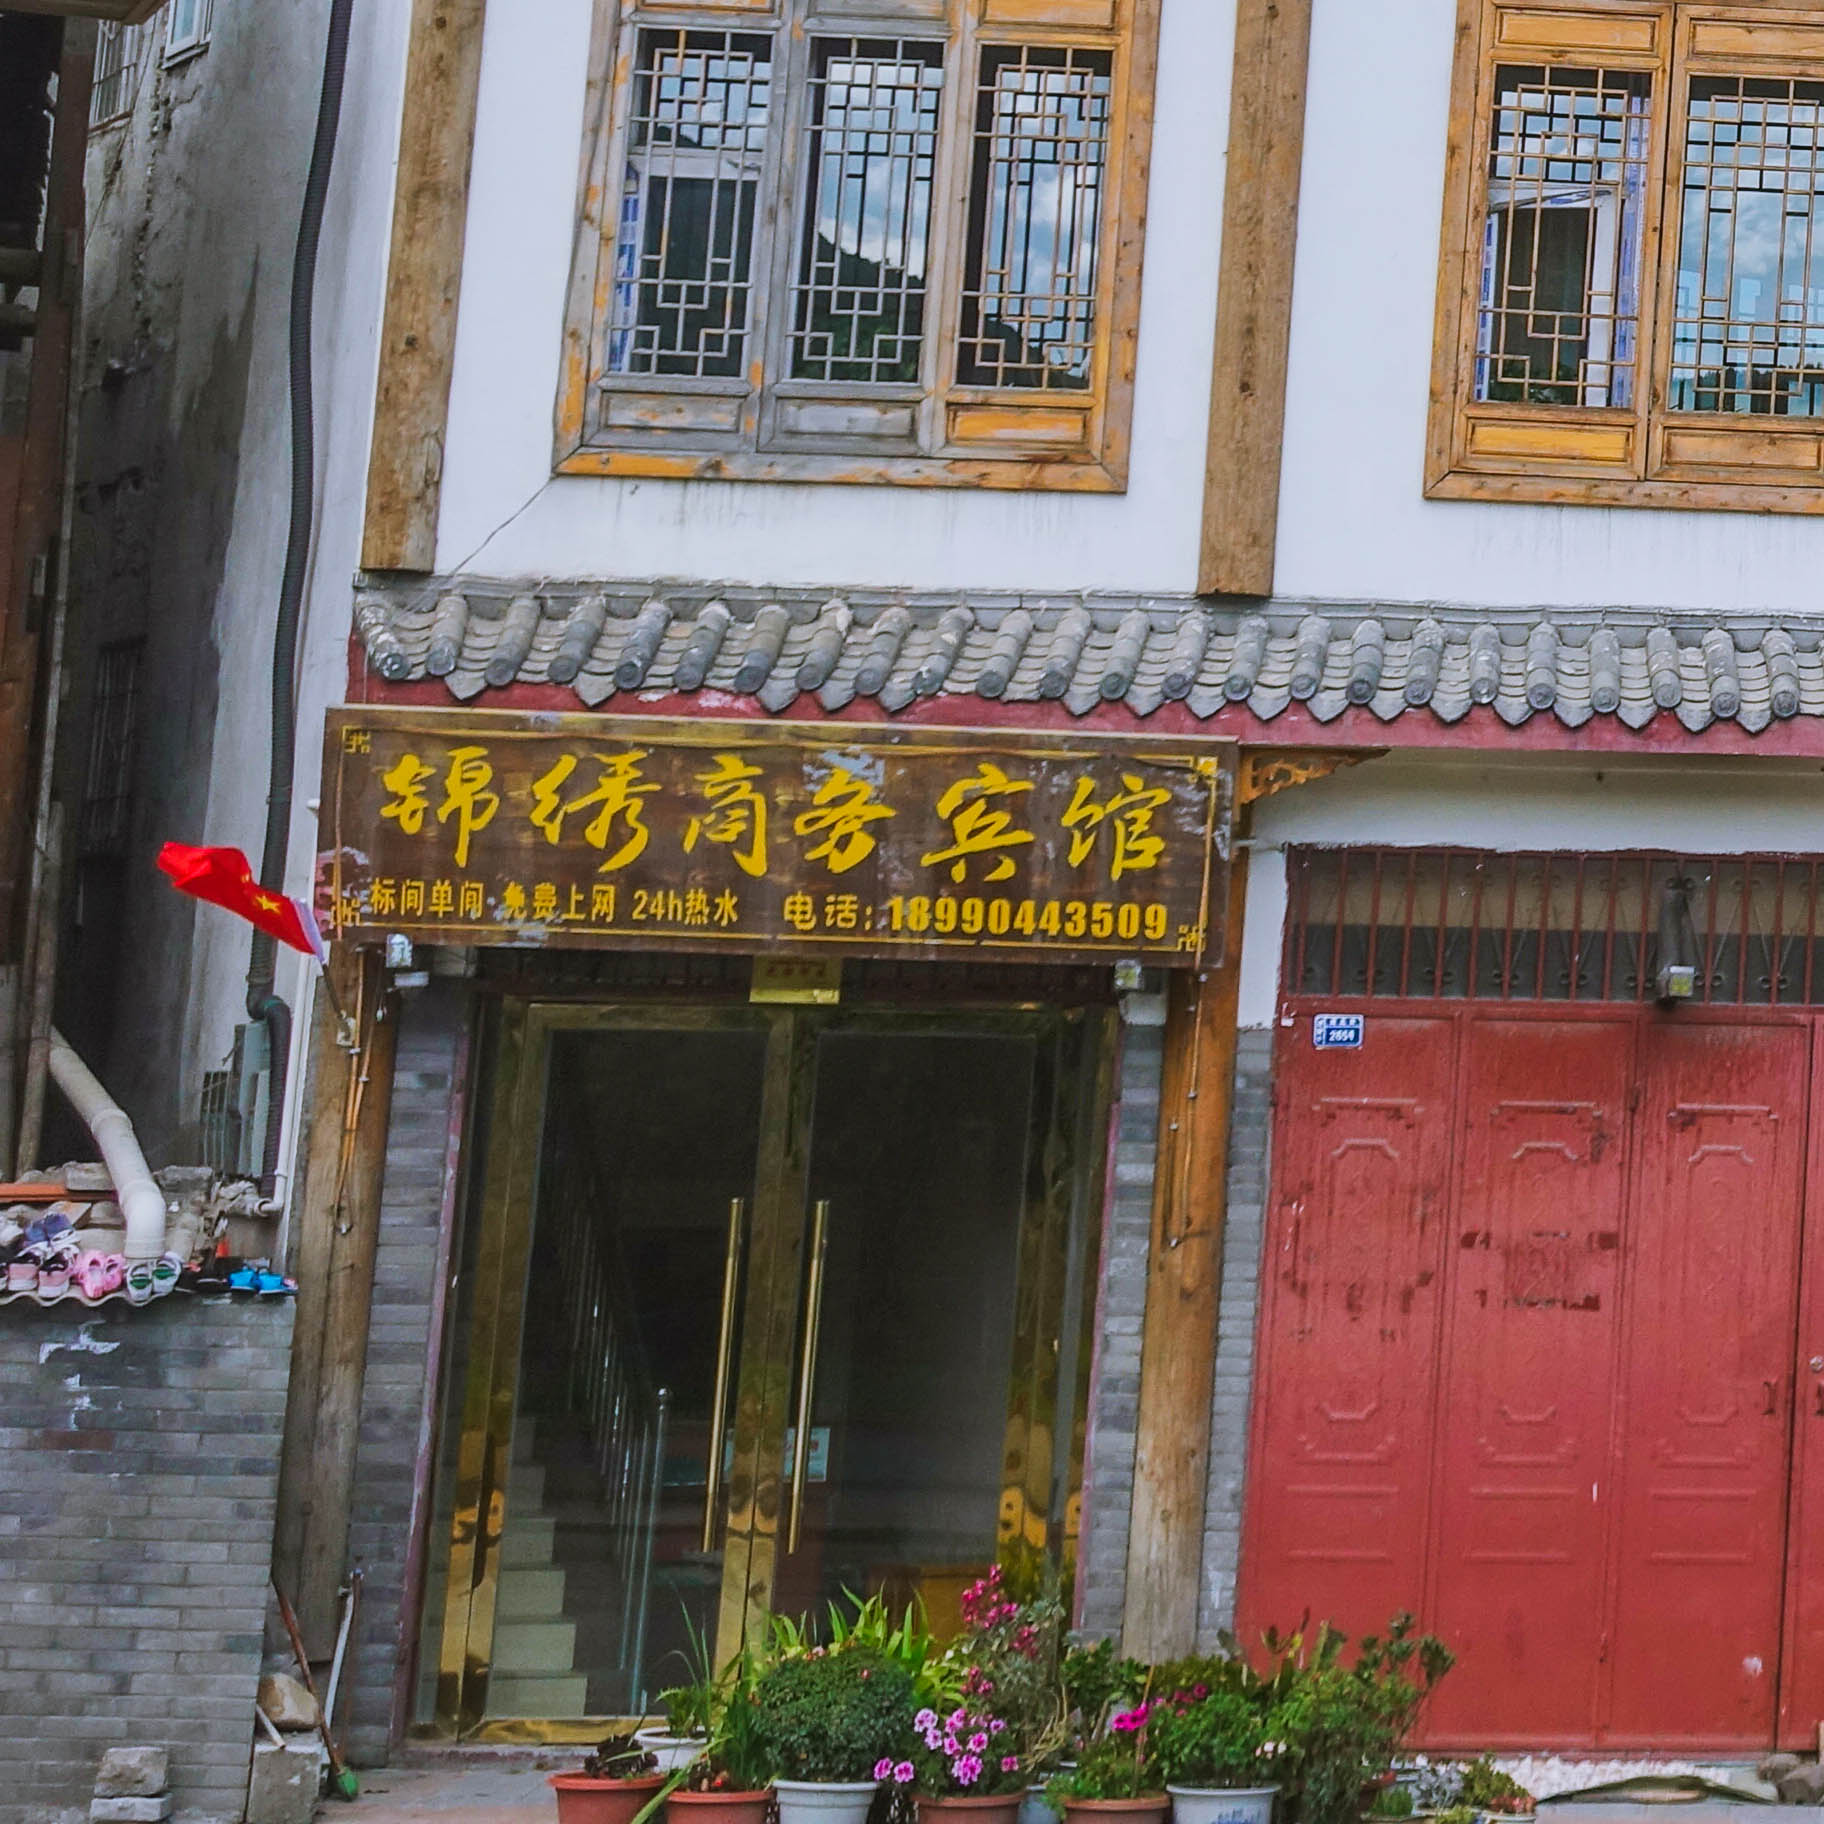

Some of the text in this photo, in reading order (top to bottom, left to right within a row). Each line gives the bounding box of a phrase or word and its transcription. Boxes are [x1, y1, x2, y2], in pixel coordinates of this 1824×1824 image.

[380, 746, 1173, 884] 锦绣商务宾馆
[369, 877, 484, 917] 标间单间
[502, 880, 617, 923] 免费上网
[631, 887, 739, 927] 24h热水
